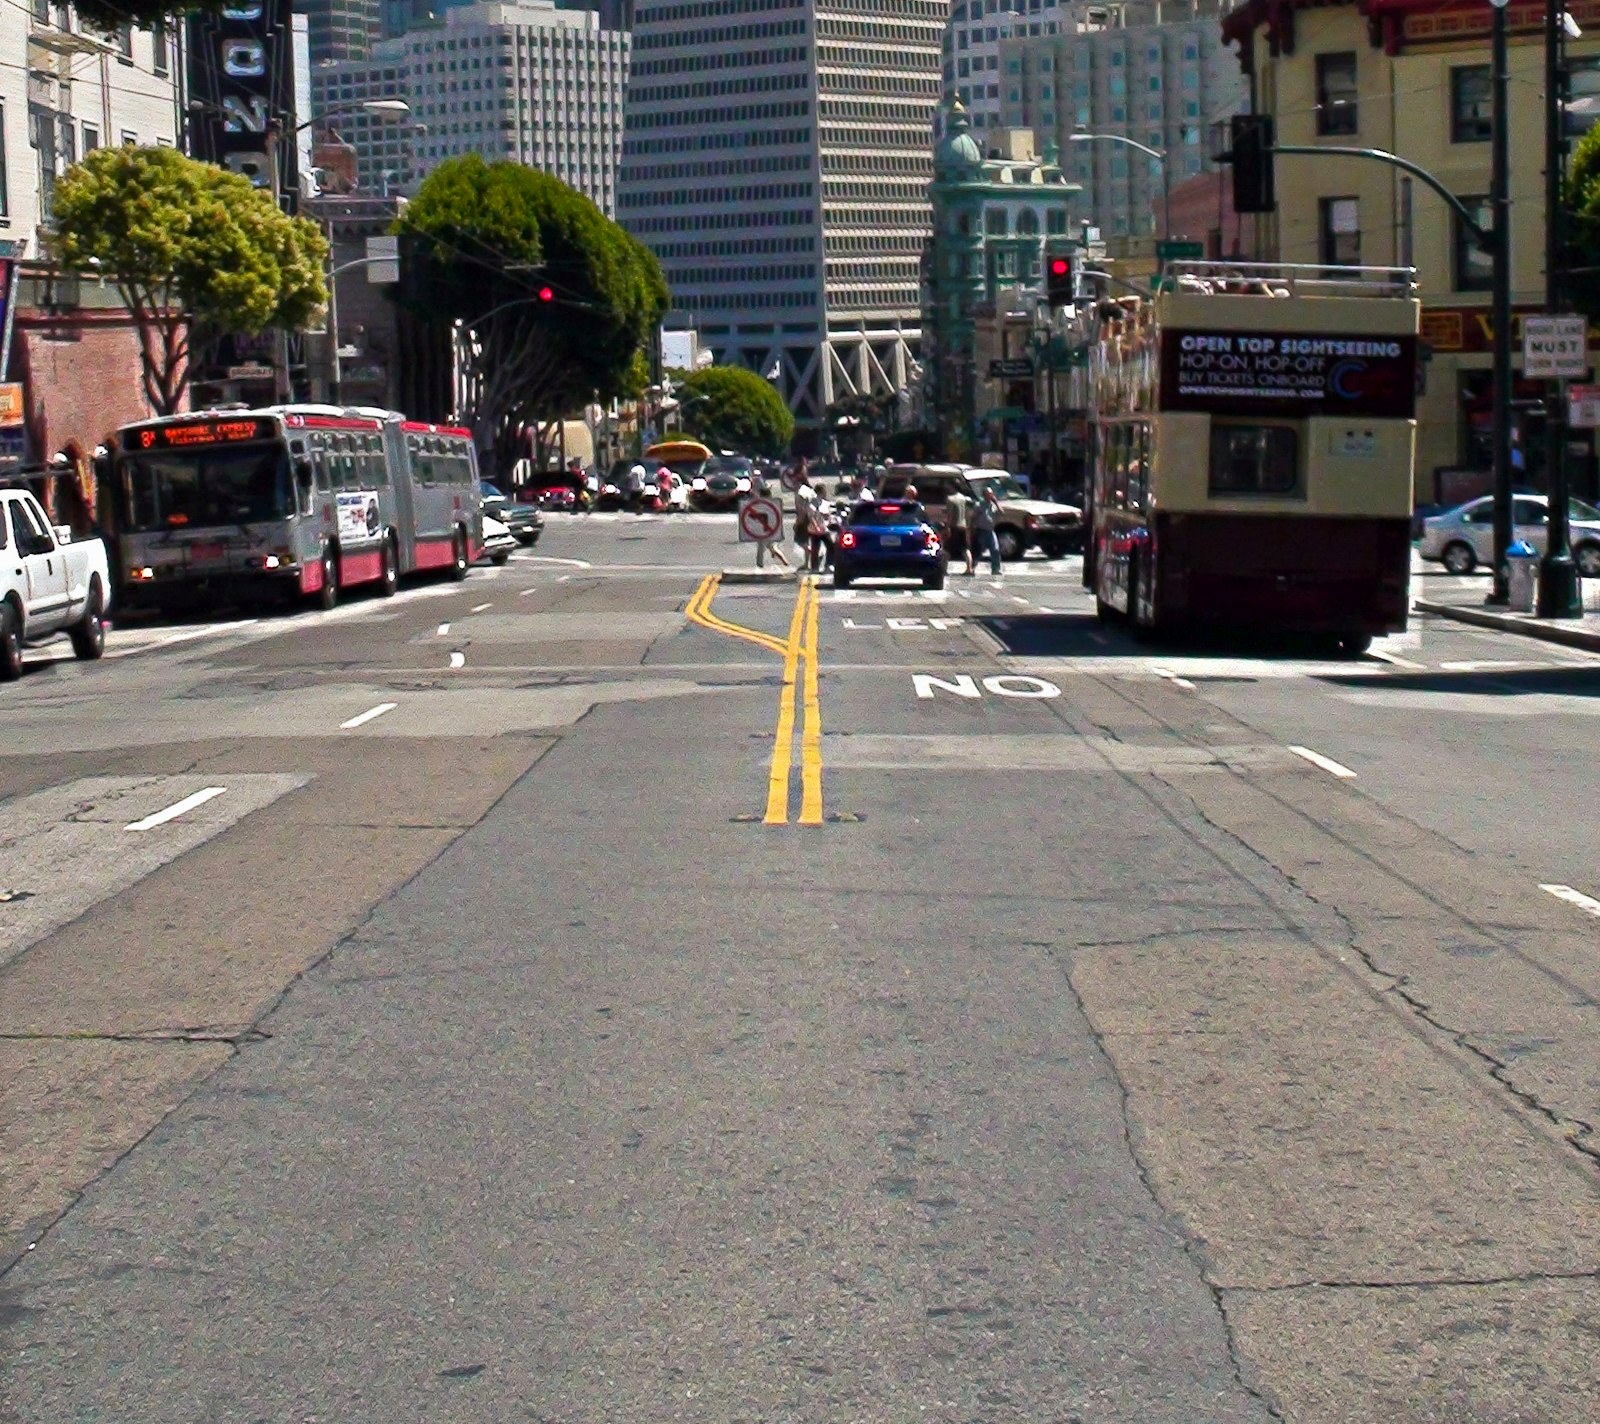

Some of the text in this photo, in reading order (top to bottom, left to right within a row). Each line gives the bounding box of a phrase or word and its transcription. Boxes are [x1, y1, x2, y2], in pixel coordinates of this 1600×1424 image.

[1181, 336, 1401, 357] OPEN TOP SIGHTSEEING
[1531, 340, 1578, 353] MUST
[1255, 355, 1326, 372] HOP-OFF
[1179, 372, 1326, 387] BUY TICKETS ONBOARD
[911, 675, 1062, 698] NO
